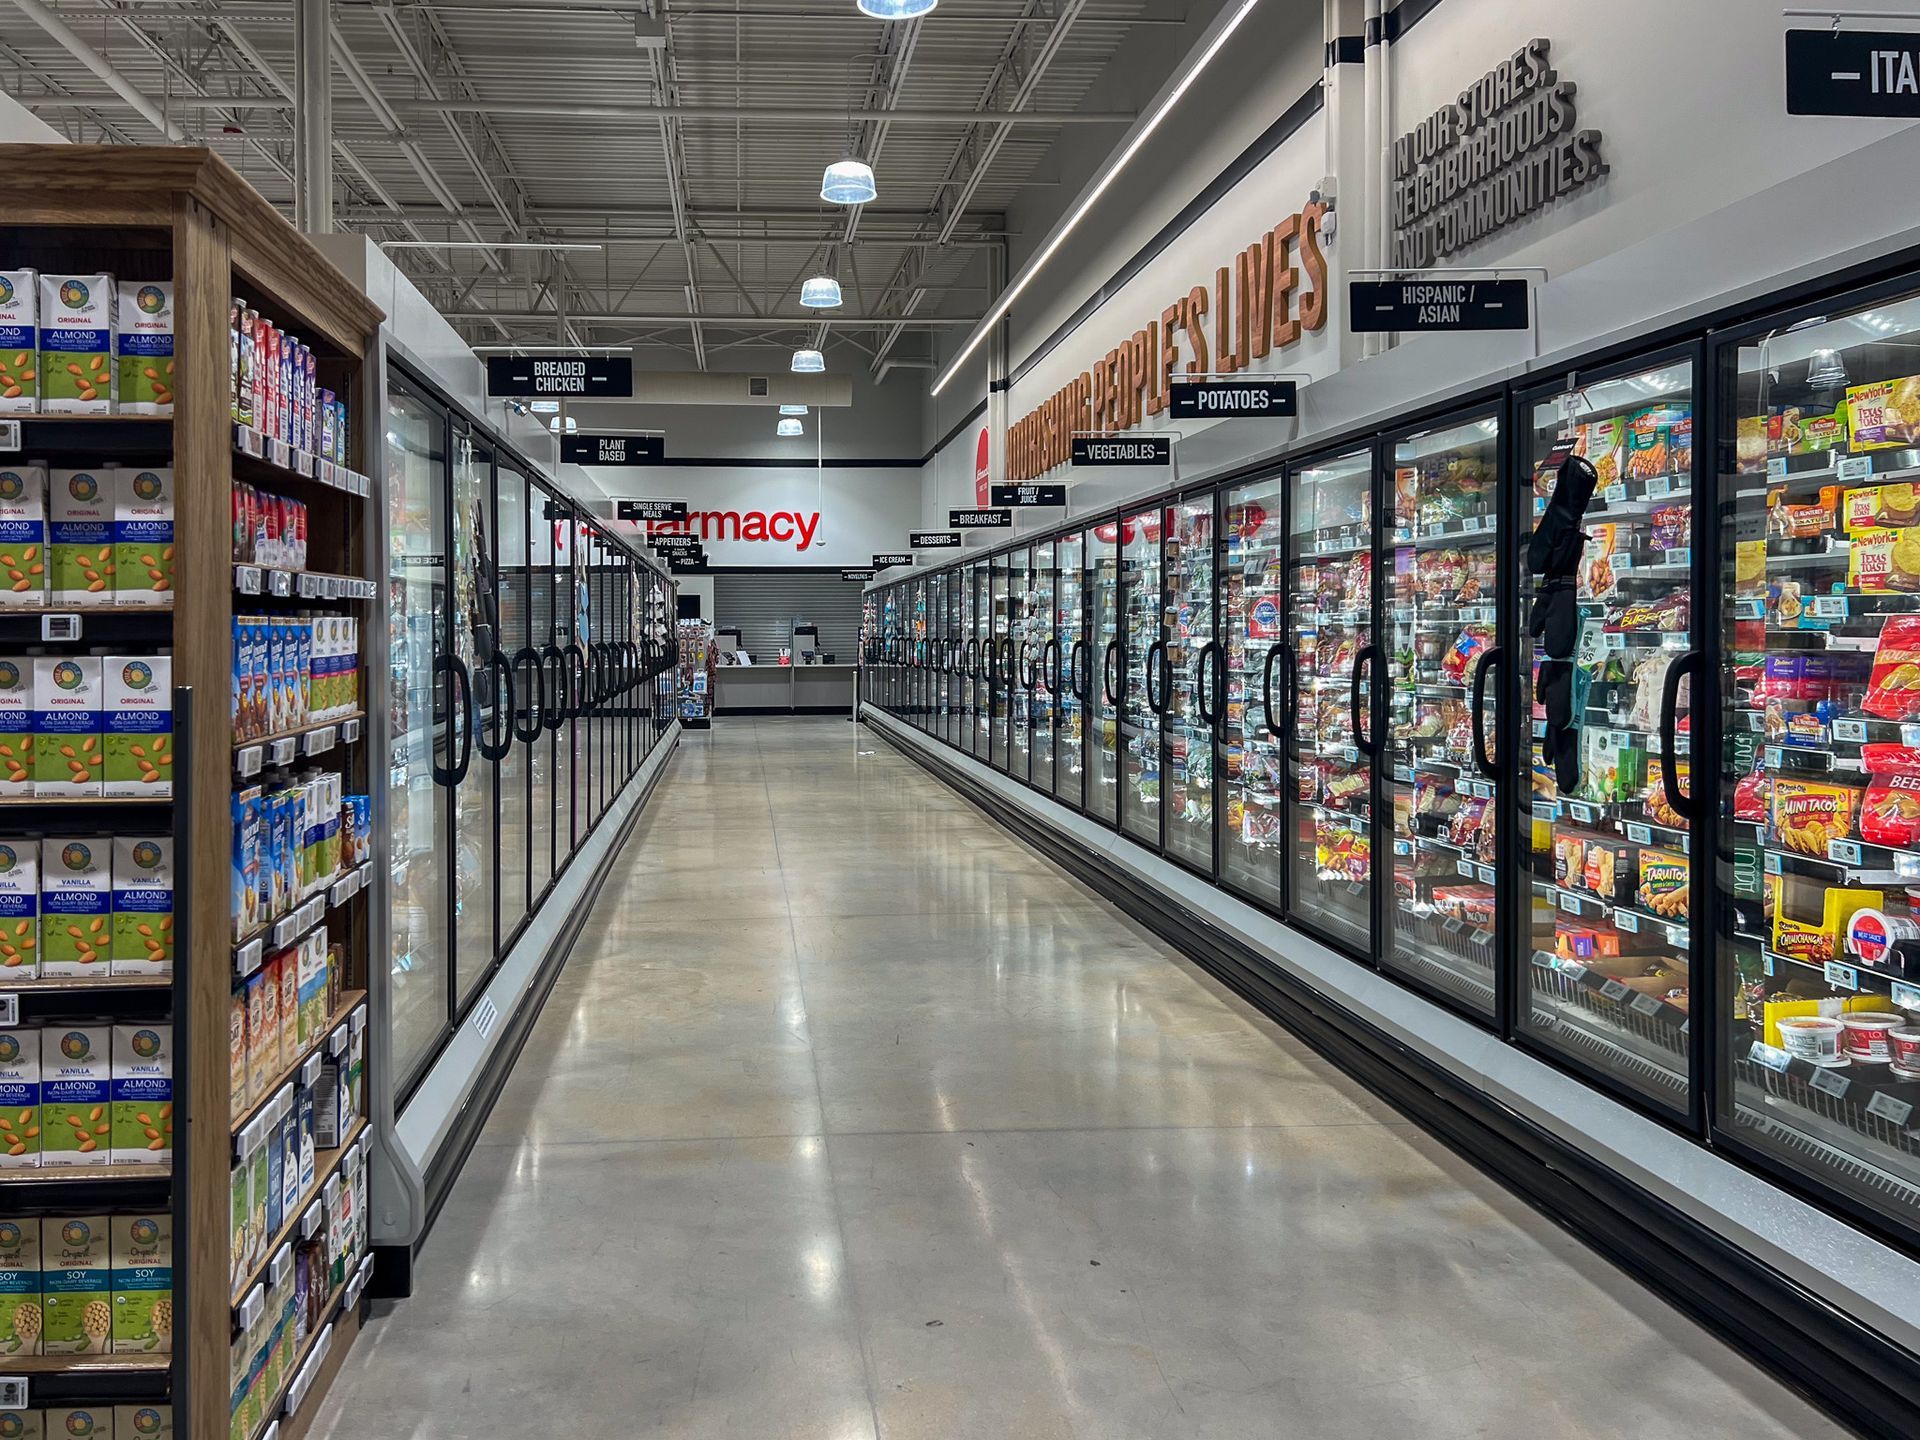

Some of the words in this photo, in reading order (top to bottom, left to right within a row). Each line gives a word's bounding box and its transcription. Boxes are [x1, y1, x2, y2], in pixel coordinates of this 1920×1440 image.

[1871, 51, 1920, 94] ITA
[1414, 104, 1459, 165] OUR
[1456, 37, 1557, 137] STORES,
[1393, 81, 1577, 231] NEIGHBORHOODS
[1432, 129, 1610, 258] COMMUNITIES.
[1215, 201, 1328, 378] LIVES
[1402, 285, 1466, 304] HISPANIC
[1418, 305, 1460, 323] ASIAN
[52, 331, 96, 339] ALMOND
[129, 336, 172, 344] ALMOND
[534, 362, 586, 376] BREADED
[535, 377, 585, 392] CHICKEN
[1198, 390, 1269, 410] POTATOES
[1858, 406, 1883, 418] TEXAS
[1858, 415, 1884, 427] TOAST
[599, 439, 626, 450] PLANT
[599, 450, 626, 461] BASED
[1087, 444, 1155, 460] VEGETABLES
[1018, 487, 1034, 496] FRUIT
[1020, 495, 1037, 504] JUICE
[633, 503, 653, 511] SINGLE
[654, 503, 672, 511] SERVE
[959, 514, 1002, 525] BREAKFAST
[61, 523, 104, 531] ALMOND
[655, 538, 691, 547] APPETIZERS
[920, 536, 951, 545] DESSERTS
[1861, 554, 1886, 563] TEXAS
[1861, 562, 1886, 572] TOAST
[46, 713, 89, 721] ALMOND
[115, 712, 159, 720] ALMOND
[1889, 775, 1920, 791] BEE
[1783, 800, 1807, 816] MINI
[1808, 799, 1838, 812] TACOS
[54, 893, 96, 901] ALMOND
[124, 891, 166, 899] ALMOND
[53, 1082, 96, 1090] ALMOND
[123, 1080, 166, 1088] ALMOND
[67, 1272, 86, 1280] SOY
[135, 1269, 155, 1278] SOY
